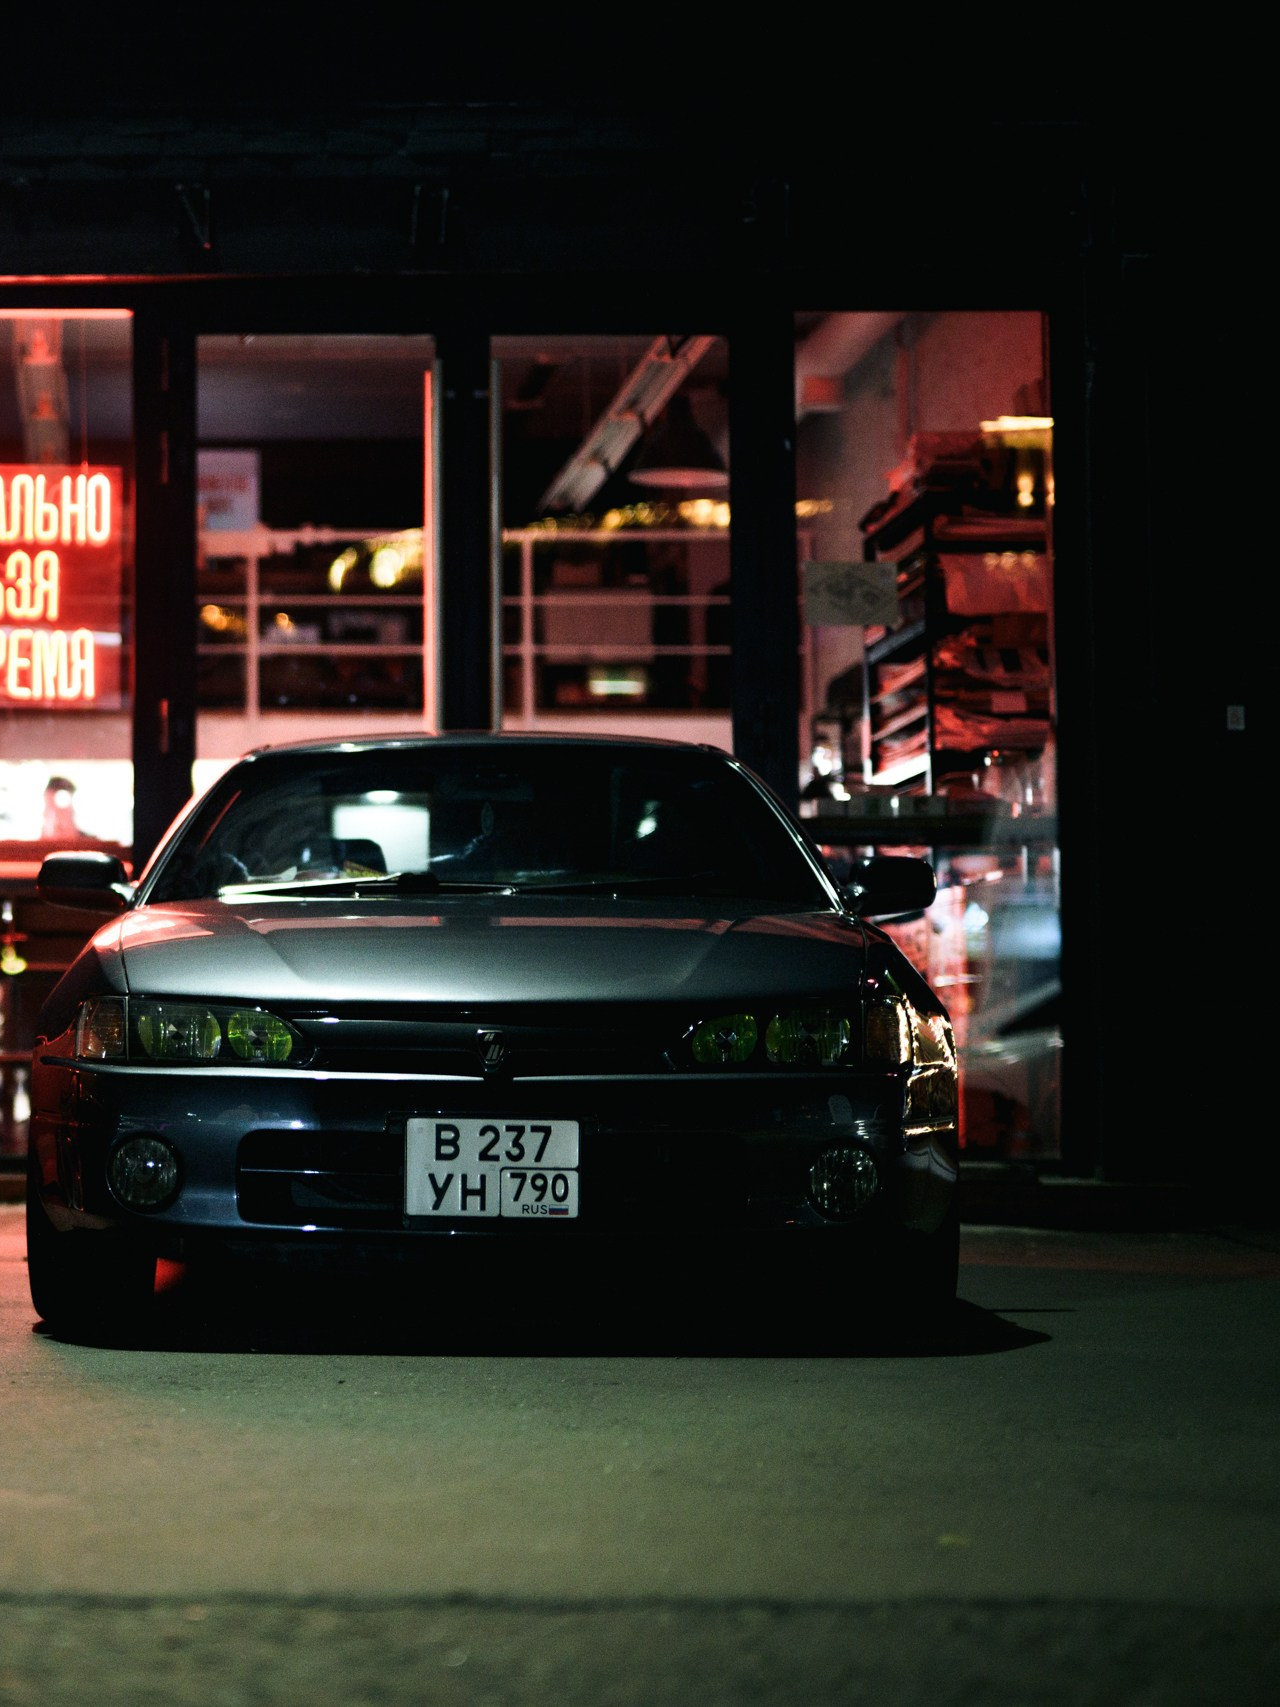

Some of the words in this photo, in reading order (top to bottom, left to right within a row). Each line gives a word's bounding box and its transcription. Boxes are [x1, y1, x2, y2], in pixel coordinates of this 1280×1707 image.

[478, 1124, 552, 1163] 237
[509, 1172, 569, 1203] 790
[522, 1204, 548, 1215] RUS
